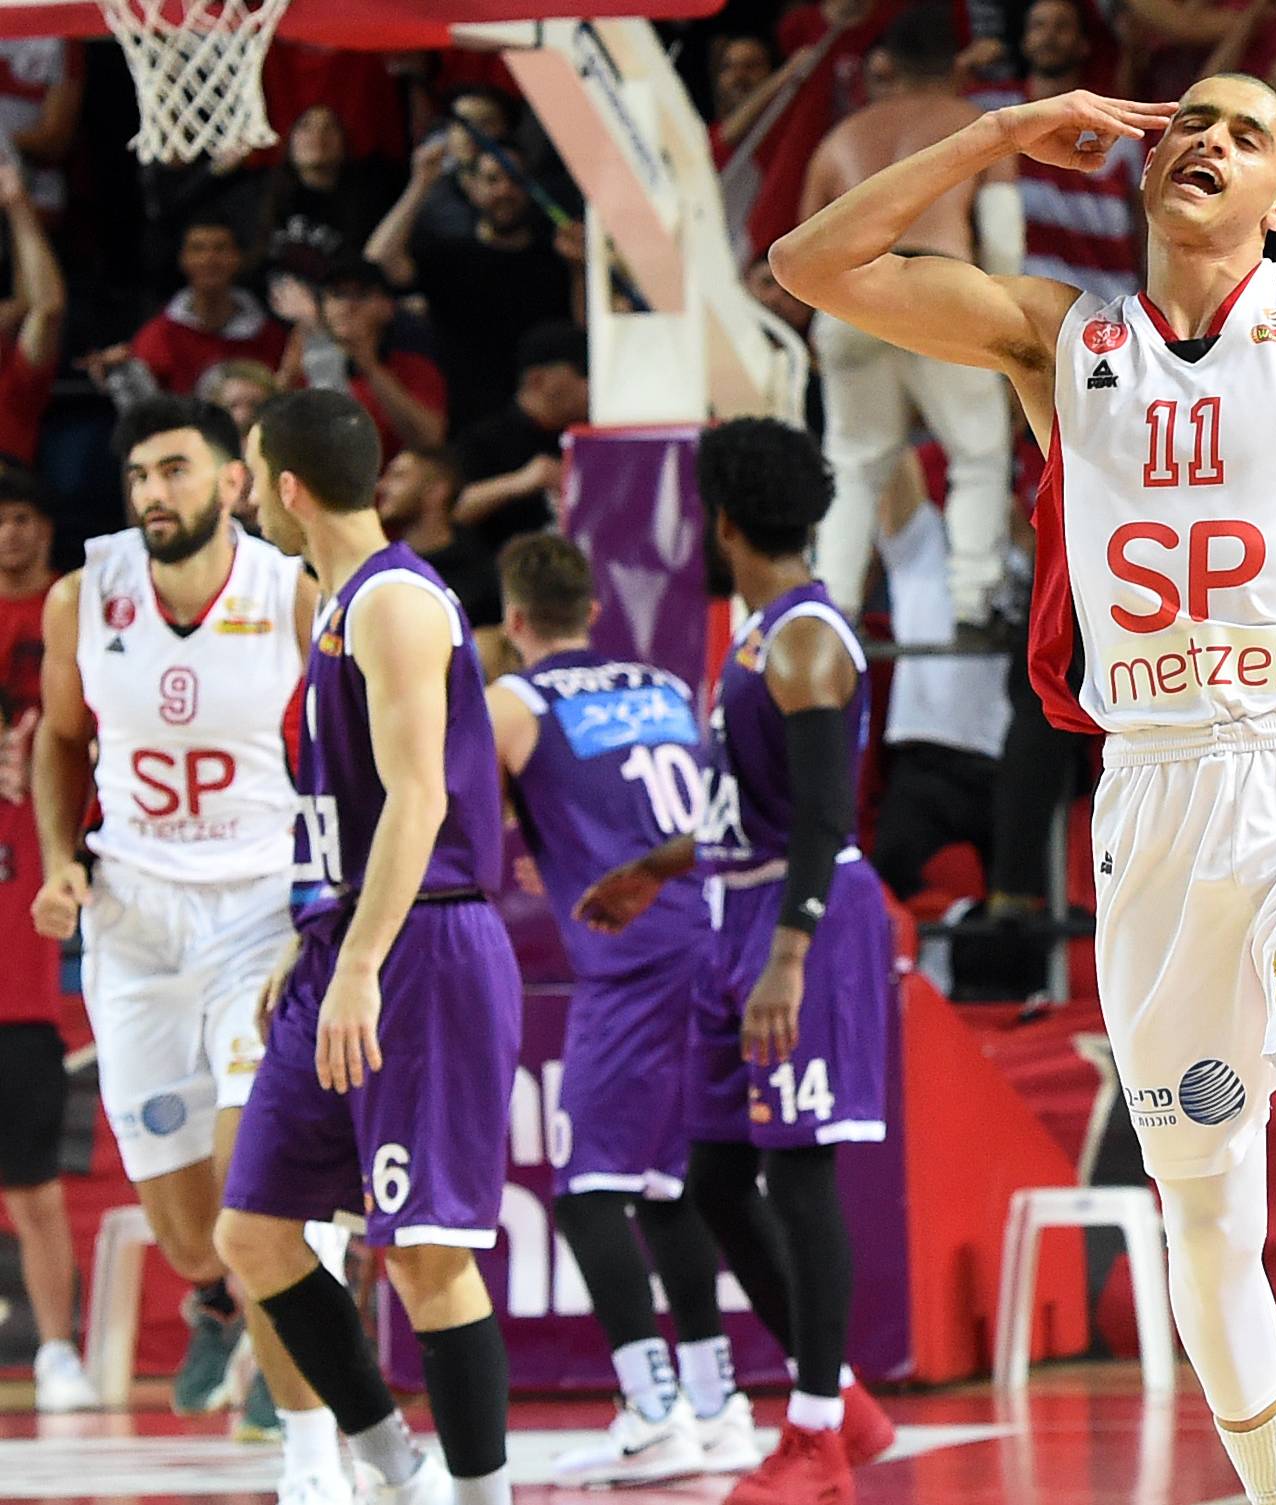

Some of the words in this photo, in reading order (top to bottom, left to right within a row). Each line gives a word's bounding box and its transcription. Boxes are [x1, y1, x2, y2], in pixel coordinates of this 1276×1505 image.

[1143, 396, 1224, 488] 11
[1106, 519, 1266, 634] SP
[159, 666, 198, 726] 9
[130, 746, 237, 818] SP
[620, 743, 701, 834] 10
[769, 1058, 835, 1124] 14
[372, 1143, 411, 1215] 6
